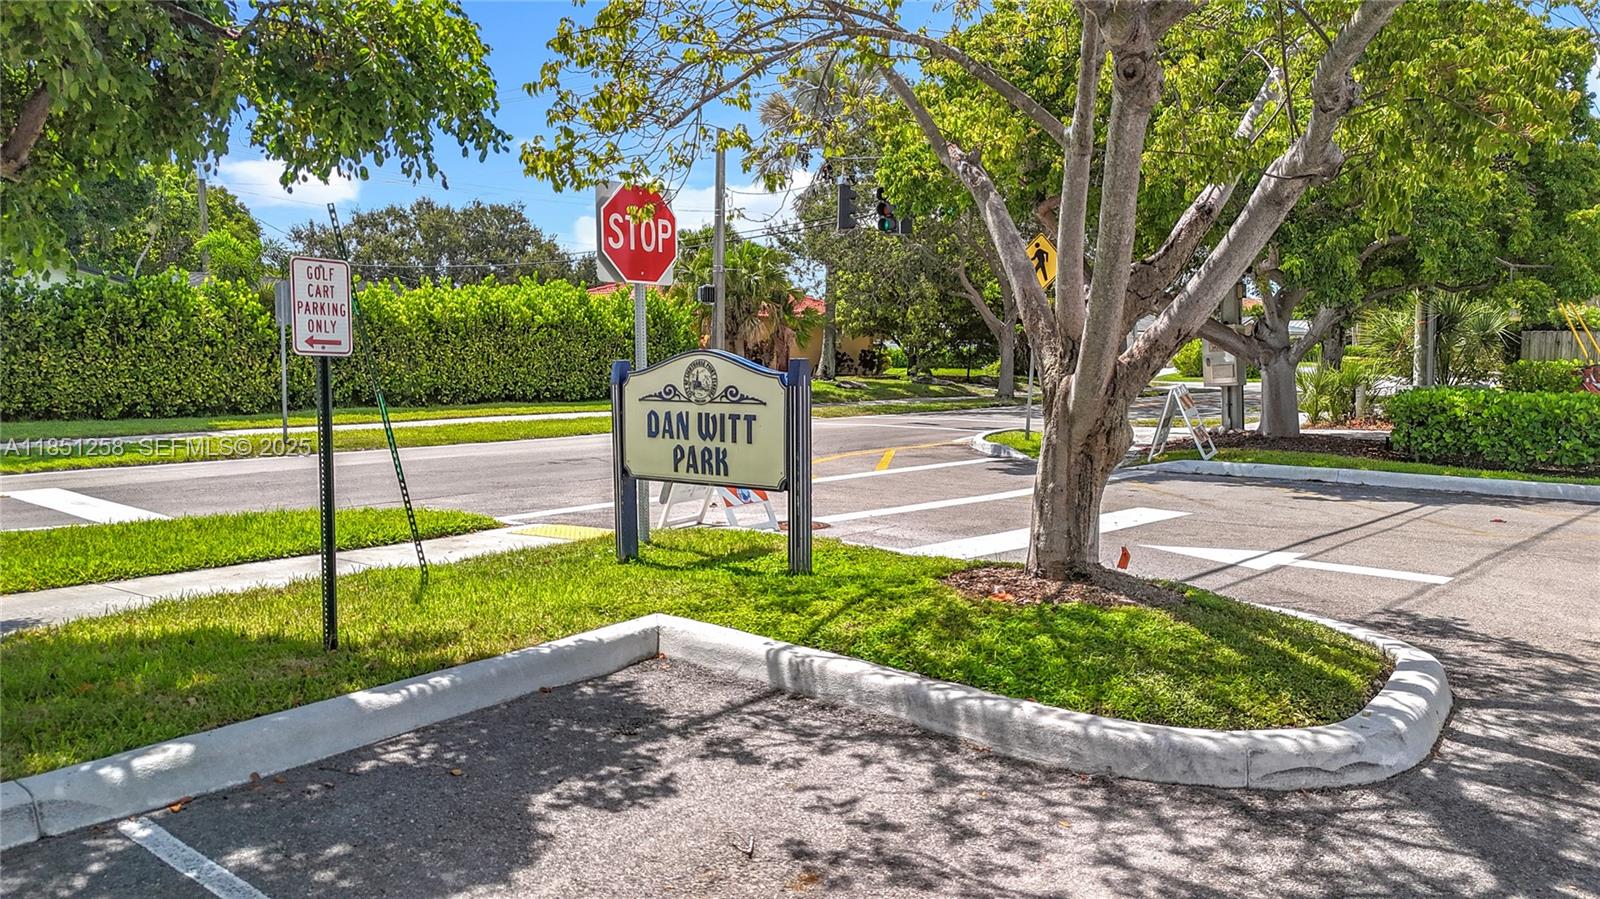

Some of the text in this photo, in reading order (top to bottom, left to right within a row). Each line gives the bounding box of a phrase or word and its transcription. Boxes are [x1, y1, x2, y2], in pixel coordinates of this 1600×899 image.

[608, 213, 672, 253] STOP
[307, 266, 335, 281] GOLF
[307, 284, 335, 299] CART
[297, 301, 346, 317] PARKING
[307, 319, 337, 334] ONLY
[647, 409, 757, 444] DAN WITT
[673, 444, 729, 477] PARK
